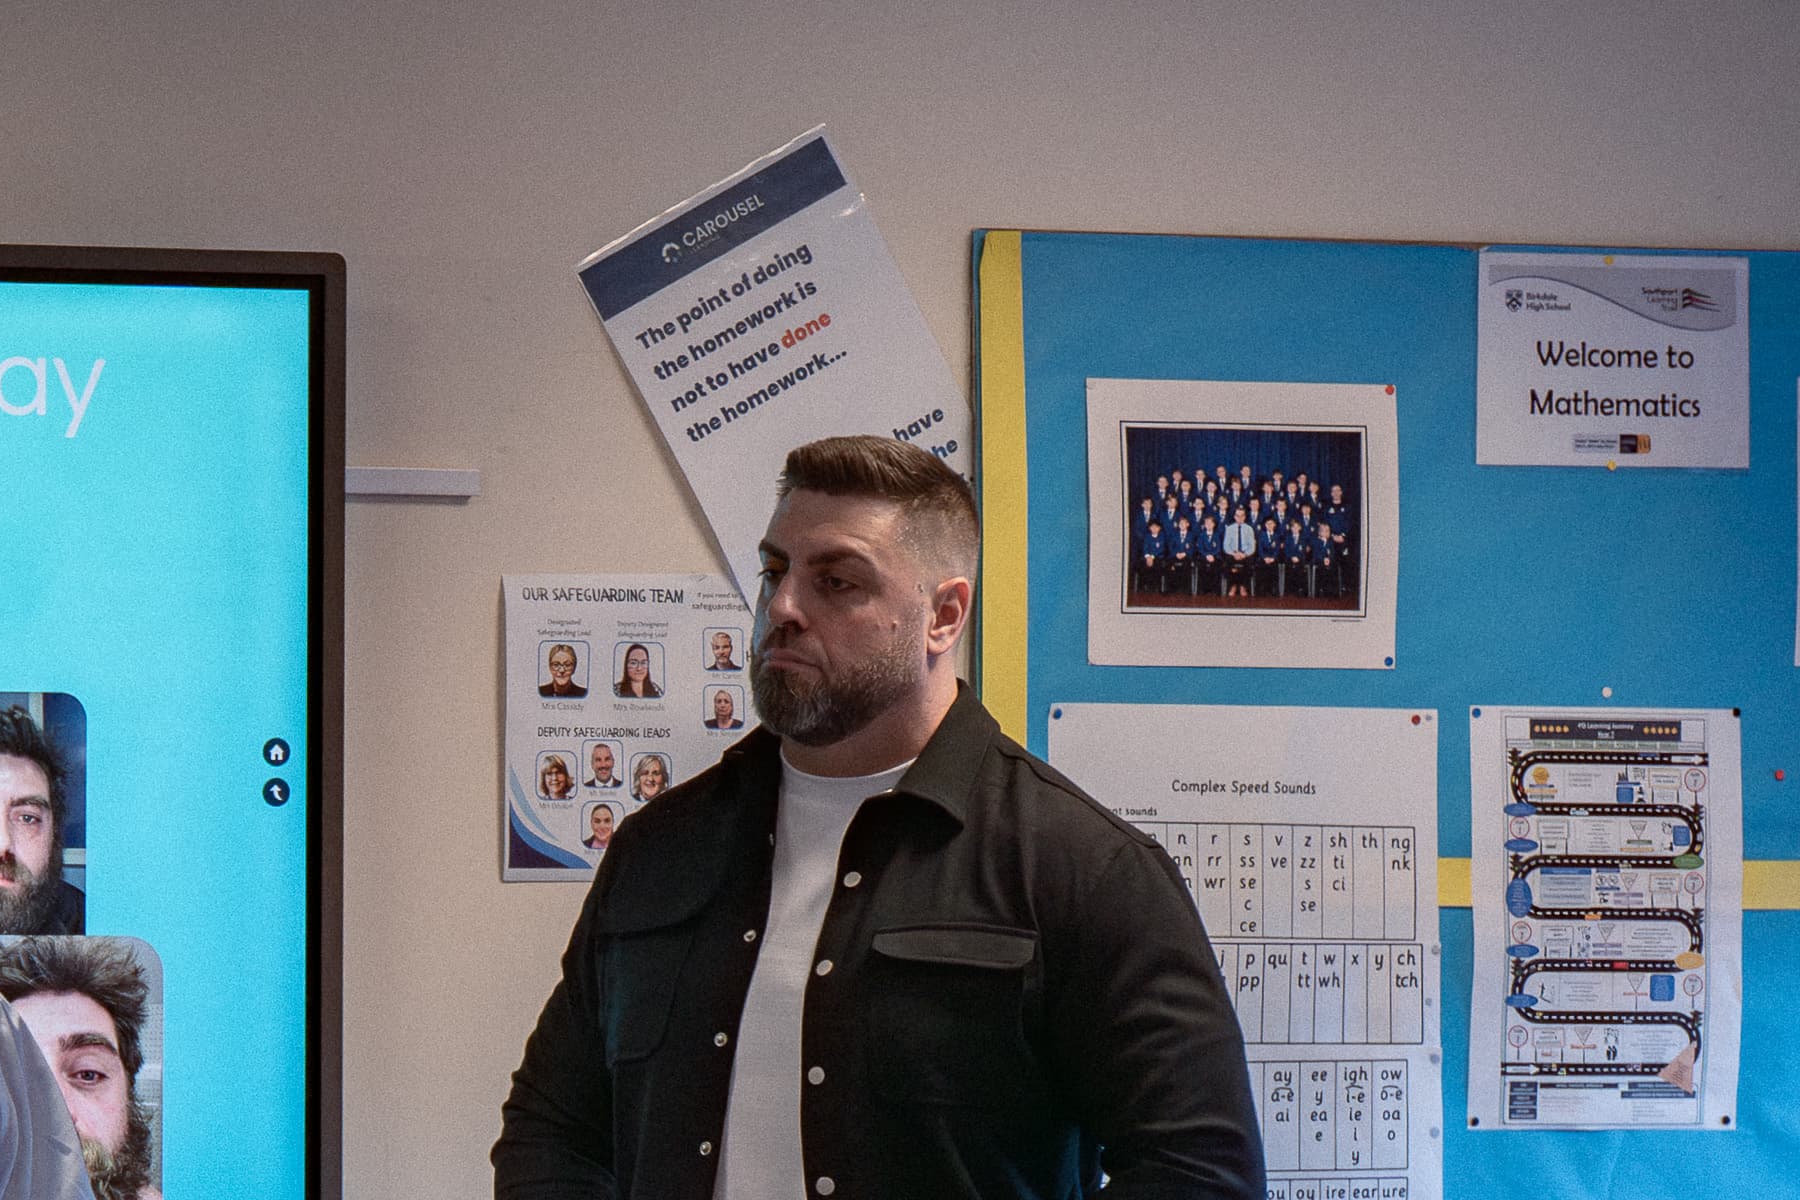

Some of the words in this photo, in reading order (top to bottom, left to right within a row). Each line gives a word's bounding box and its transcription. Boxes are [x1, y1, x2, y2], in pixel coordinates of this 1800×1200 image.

[682, 194, 765, 247] CAROUSEL
[635, 321, 677, 350] The
[676, 287, 732, 334] point
[732, 272, 753, 297] of
[753, 244, 813, 285] doing
[654, 354, 690, 381] the
[688, 291, 799, 362] homework
[795, 280, 817, 300] is
[671, 382, 707, 413] not
[705, 371, 729, 391] to
[728, 341, 780, 379] have
[781, 312, 832, 349] done
[1536, 340, 1658, 368] Welcome
[1667, 344, 1694, 369] to
[686, 415, 722, 443] the
[720, 350, 848, 424] homework...
[1529, 388, 1701, 418] Mathematics
[892, 408, 944, 442] have
[522, 586, 549, 601] OUR
[553, 587, 646, 603] SAFEGUARDING
[649, 588, 684, 605] TEAM
[538, 726, 571, 738] DEPUTY
[573, 726, 640, 738] SAFEGUARDING
[643, 727, 671, 738] LEADS
[1172, 779, 1227, 796] Complex
[1231, 780, 1269, 796] Speed
[1274, 781, 1317, 796] Sounds
[1125, 806, 1158, 817] sounds
[1177, 833, 1187, 845] n
[1211, 833, 1218, 845] r
[1243, 834, 1251, 846] s
[1275, 834, 1283, 846] v
[1303, 835, 1312, 847] z
[1329, 832, 1348, 848] sh
[1361, 833, 1378, 848] th
[1391, 836, 1411, 853] ng
[1207, 856, 1222, 867] rr
[1240, 857, 1255, 868] ss
[1271, 858, 1288, 869] ve
[1300, 858, 1317, 870] zz
[1333, 855, 1345, 870] ti
[1391, 857, 1411, 871] nk
[1204, 877, 1226, 890] wr
[1240, 877, 1257, 890] se
[1304, 880, 1311, 891] s
[1332, 876, 1346, 891] ci
[1244, 900, 1252, 911] c
[1300, 900, 1316, 912] se
[1240, 919, 1257, 932] ce
[1245, 953, 1255, 969] p
[1267, 953, 1287, 969] qu
[1302, 950, 1308, 965] t
[1324, 953, 1336, 965] w
[1351, 954, 1359, 966] x
[1375, 954, 1384, 970] y
[1397, 949, 1416, 966] ch
[1239, 975, 1260, 992] pp
[1298, 973, 1310, 988] tt
[1318, 972, 1340, 988] wh
[1395, 973, 1418, 988] tch
[1273, 1070, 1292, 1086] ay
[1311, 1071, 1327, 1082] ee
[1344, 1066, 1368, 1086] igh
[1380, 1069, 1402, 1081] ow
[1315, 1090, 1323, 1105] y
[1275, 1109, 1290, 1122] ai
[1310, 1110, 1328, 1122] ea
[1349, 1109, 1362, 1122] ie
[1382, 1110, 1401, 1121] oa
[1315, 1131, 1323, 1142] e
[1387, 1130, 1396, 1141] o
[1351, 1151, 1360, 1165] y
[1266, 1189, 1285, 1200] ou
[1326, 1186, 1346, 1200] ire
[1353, 1188, 1378, 1200] ear
[1382, 1187, 1406, 1199] ure
